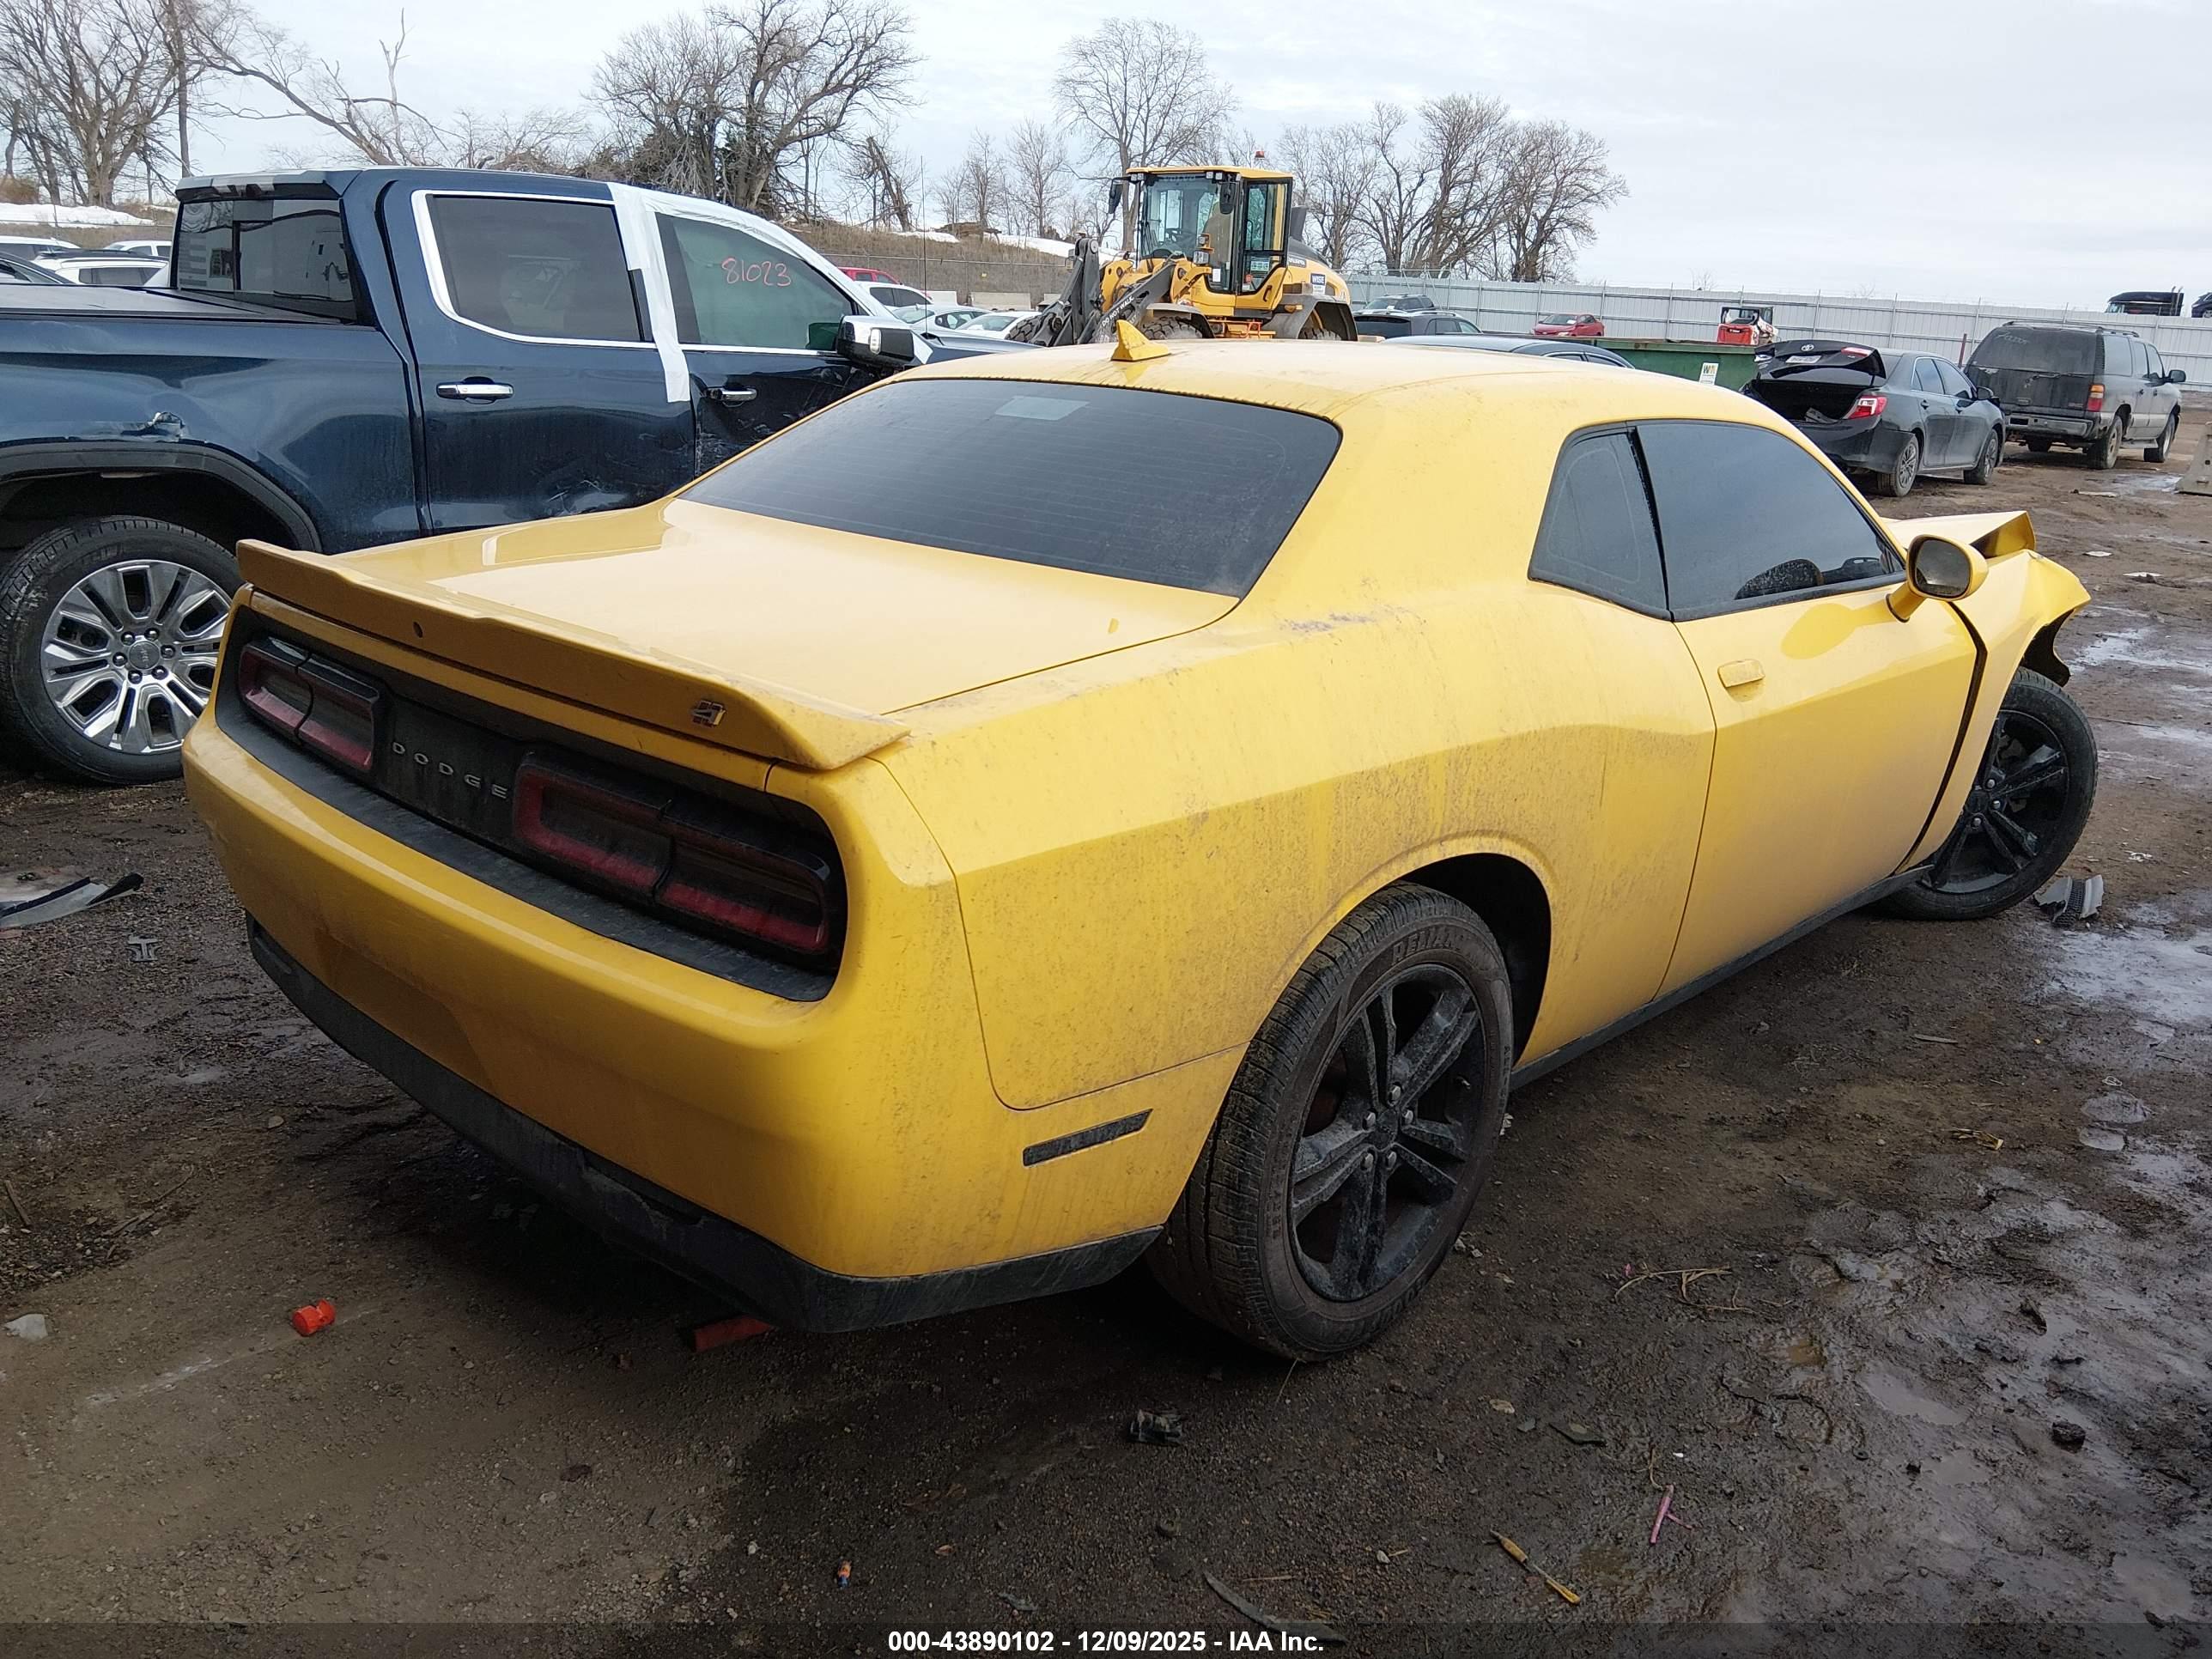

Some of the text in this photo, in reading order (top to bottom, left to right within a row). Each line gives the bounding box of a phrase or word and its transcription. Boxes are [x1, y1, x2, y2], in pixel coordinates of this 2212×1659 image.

[721, 258, 792, 287] 81023
[1109, 307, 1120, 320] NOT
[1119, 295, 1134, 310] WALK
[392, 741, 508, 799] DODGE
